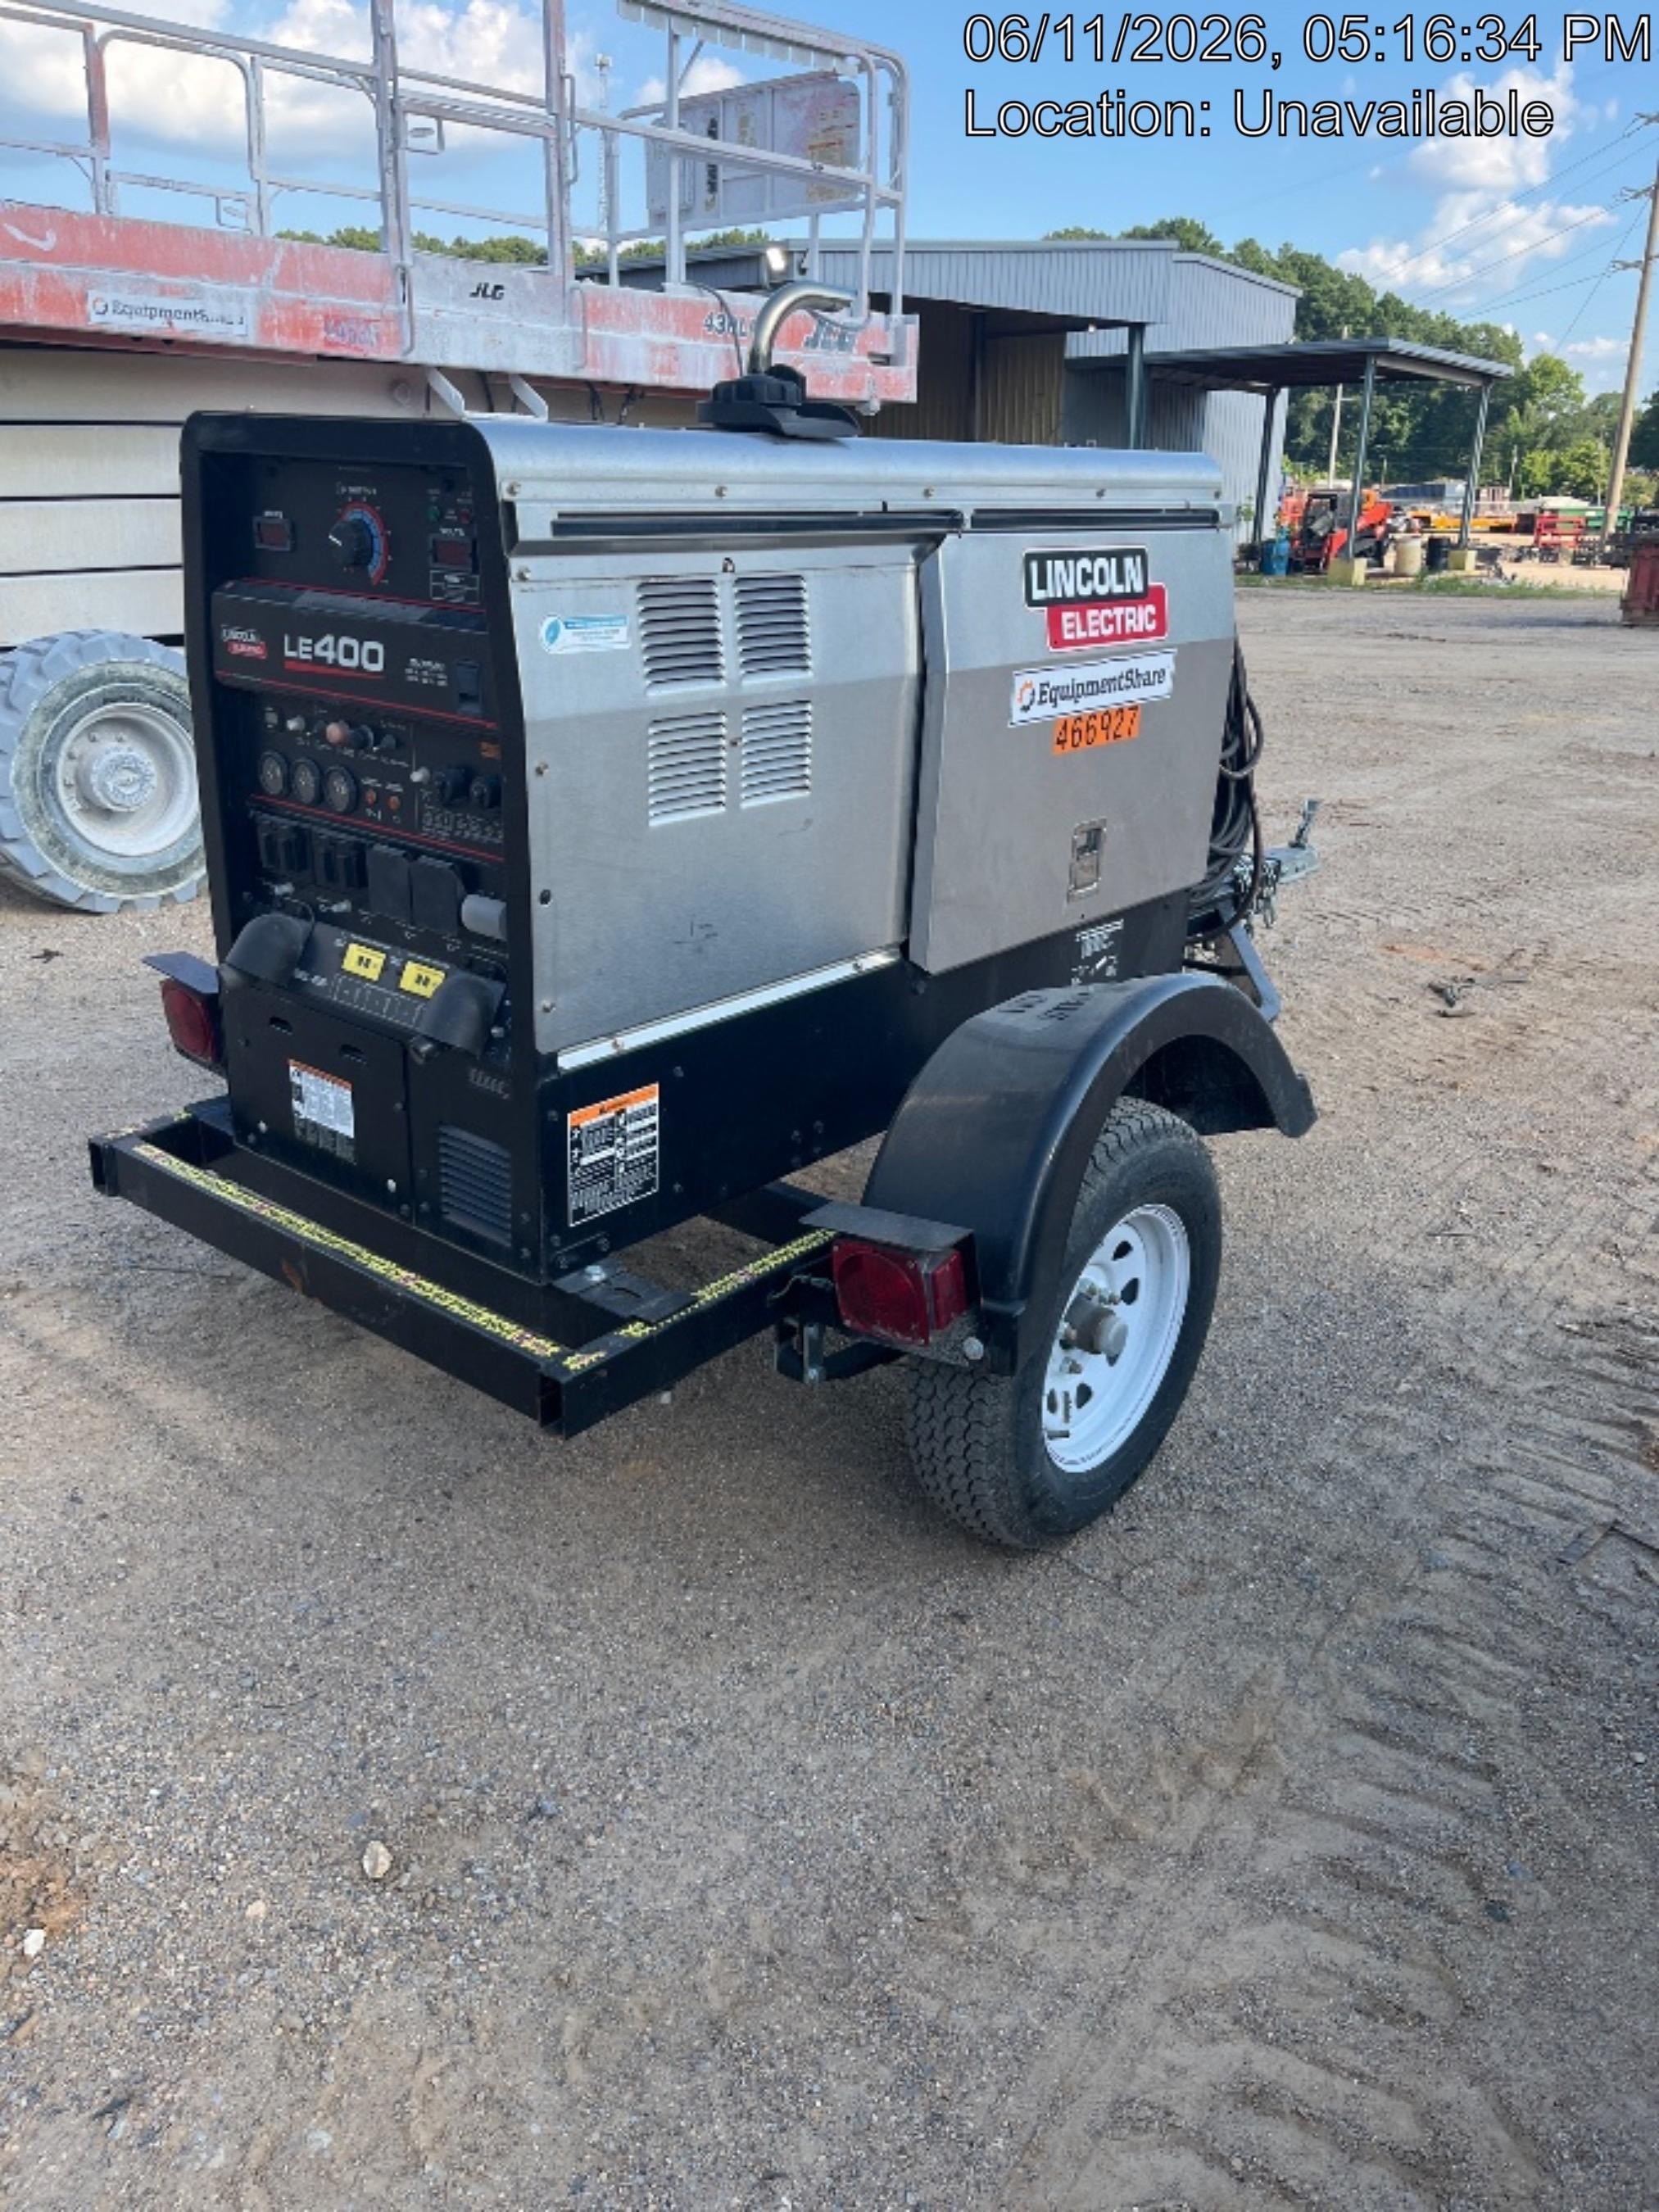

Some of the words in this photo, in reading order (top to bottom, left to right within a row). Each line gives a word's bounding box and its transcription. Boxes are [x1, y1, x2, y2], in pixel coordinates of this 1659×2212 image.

[469, 282, 504, 301] JLG
[1031, 555, 1144, 601] LINCOLN
[1062, 604, 1157, 641] ELECTRIC
[284, 633, 384, 672] LE400
[1037, 668, 1167, 708] EquipmentShare
[1055, 705, 1140, 750] 466927
